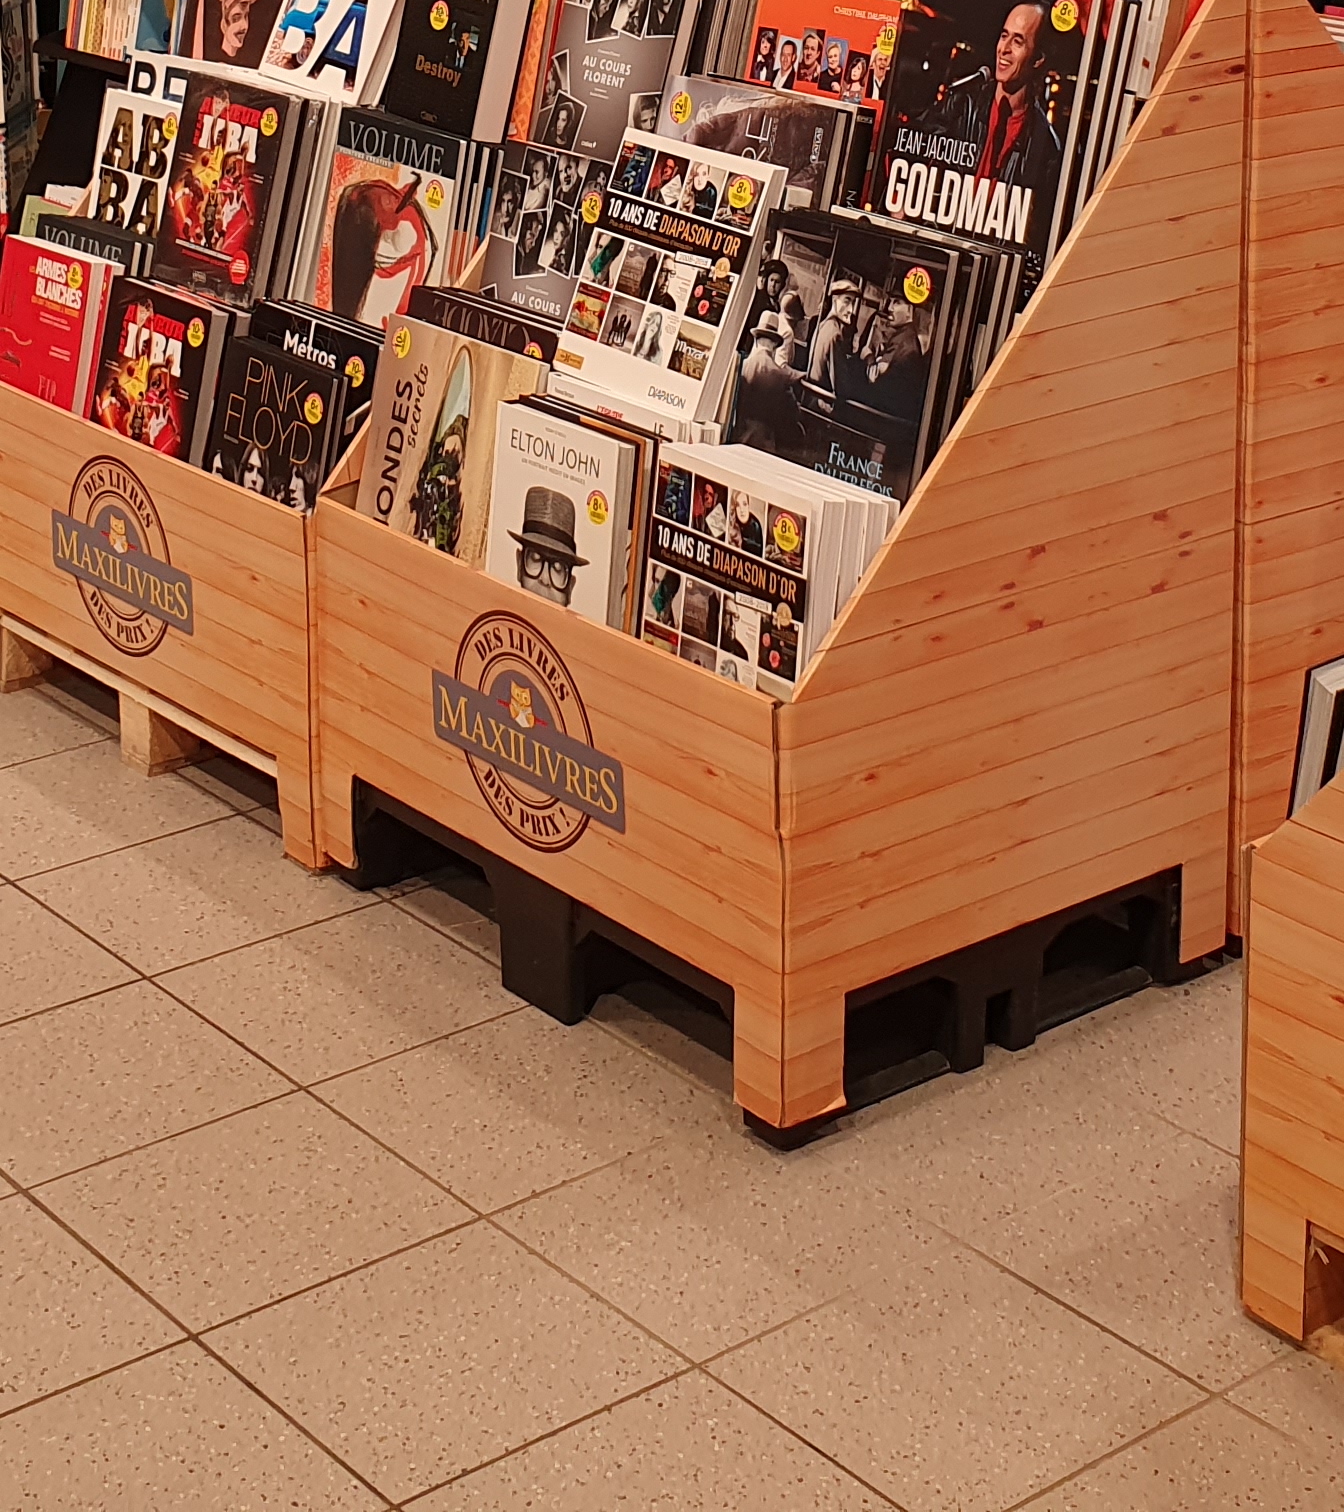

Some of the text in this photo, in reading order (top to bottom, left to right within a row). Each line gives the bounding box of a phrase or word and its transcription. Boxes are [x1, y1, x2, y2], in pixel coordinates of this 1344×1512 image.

[415, 54, 462, 87] Destroy
[583, 56, 632, 76] AU COURS
[583, 69, 625, 89] FLORENT
[348, 119, 444, 176] VOLUME
[894, 127, 978, 168] JEAN-JACQUES
[608, 197, 621, 216] 10
[622, 202, 642, 225] ANS
[644, 210, 659, 230] DE
[659, 215, 712, 248] DIAPASON
[714, 233, 741, 256] D'OR
[885, 159, 1033, 244] GOLDMAN
[35, 255, 67, 284] ARMES
[35, 279, 82, 310] BLANCHES
[283, 329, 337, 370] Métros
[244, 358, 310, 421] PINK
[407, 363, 430, 450] secrets
[224, 393, 313, 465] FLOYD
[509, 426, 602, 480] ELTON JOHN
[828, 441, 884, 482] FRANCE
[84, 473, 154, 529] DES LIVRES
[56, 522, 188, 621] MAXILIVRES
[657, 523, 797, 604] 10 ANS DE DIAPASON D'OR
[473, 632, 570, 699] DES LIVRES
[438, 684, 620, 817] MAXILIVRES
[483, 767, 515, 817] DES
[518, 806, 559, 836] PRIX
